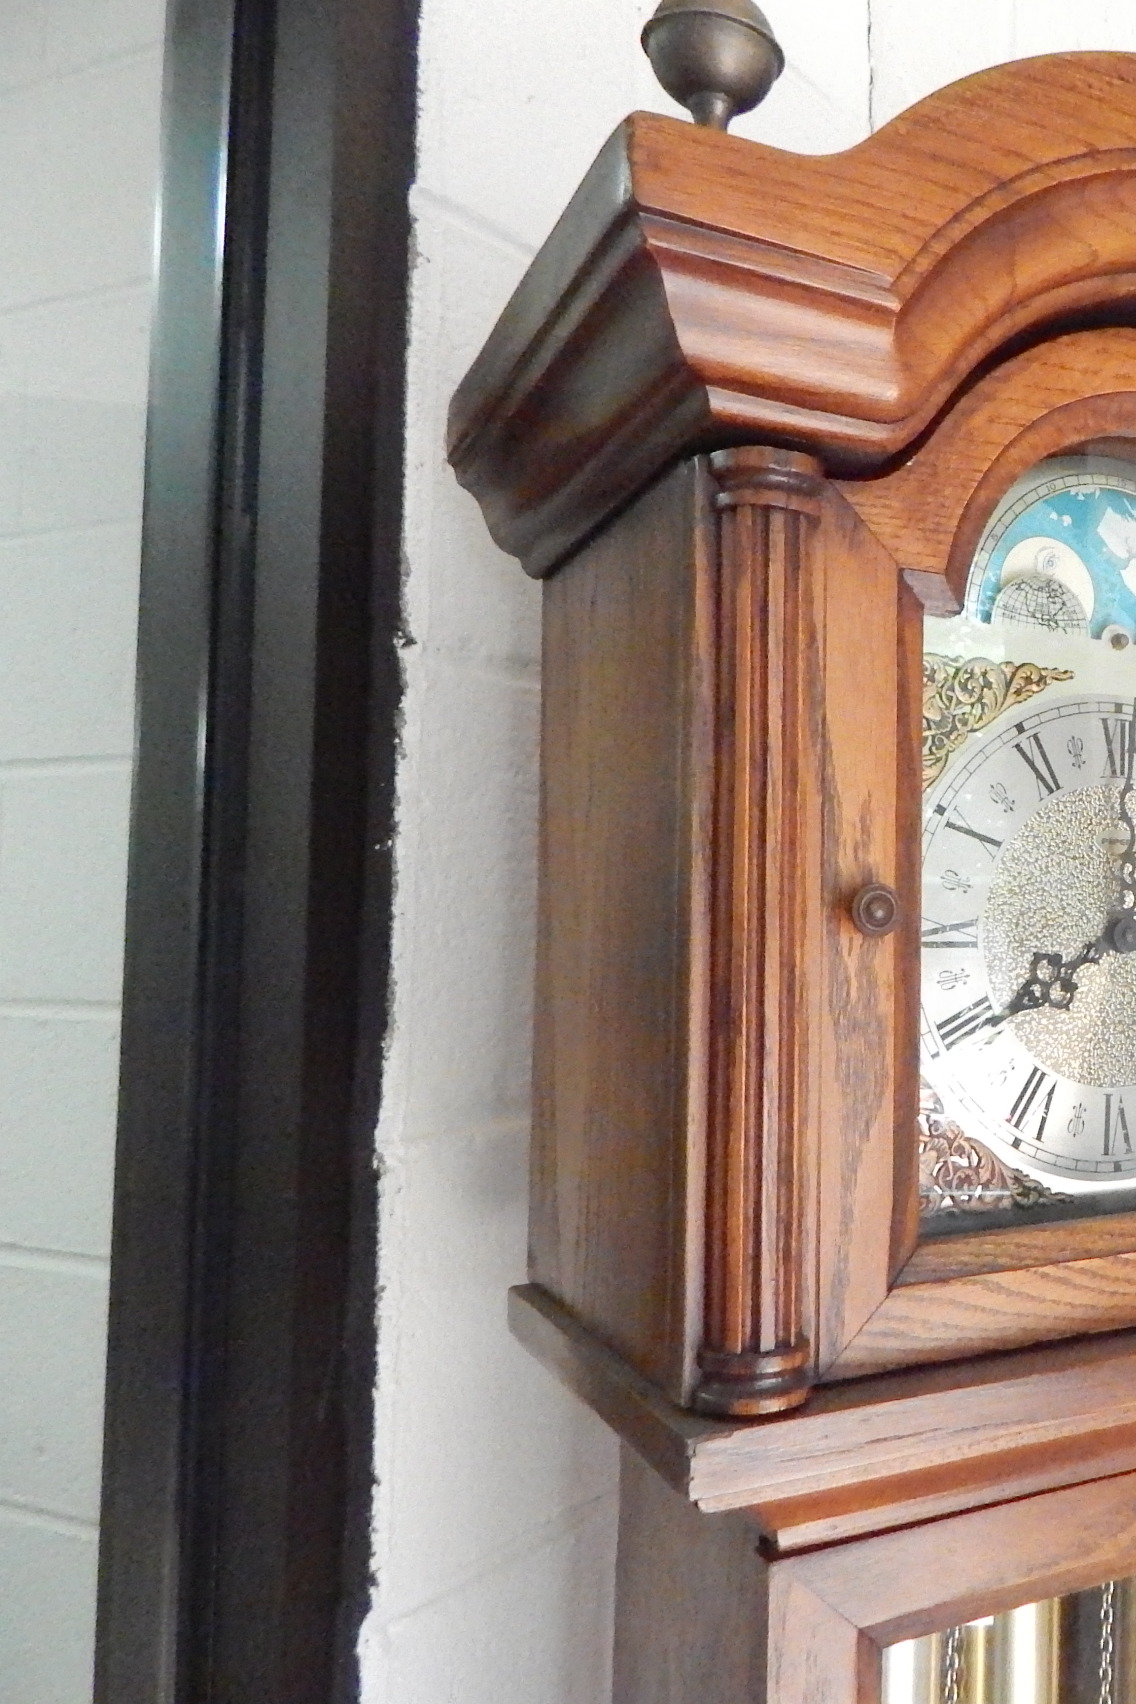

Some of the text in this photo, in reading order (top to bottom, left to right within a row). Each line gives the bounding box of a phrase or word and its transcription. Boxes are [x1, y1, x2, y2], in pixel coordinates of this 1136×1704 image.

[1012, 731, 1064, 802] XI
[943, 805, 1005, 863] X
[920, 914, 979, 951] IX
[1004, 1063, 1058, 1144] VII
[1101, 1092, 1134, 1157] VI
